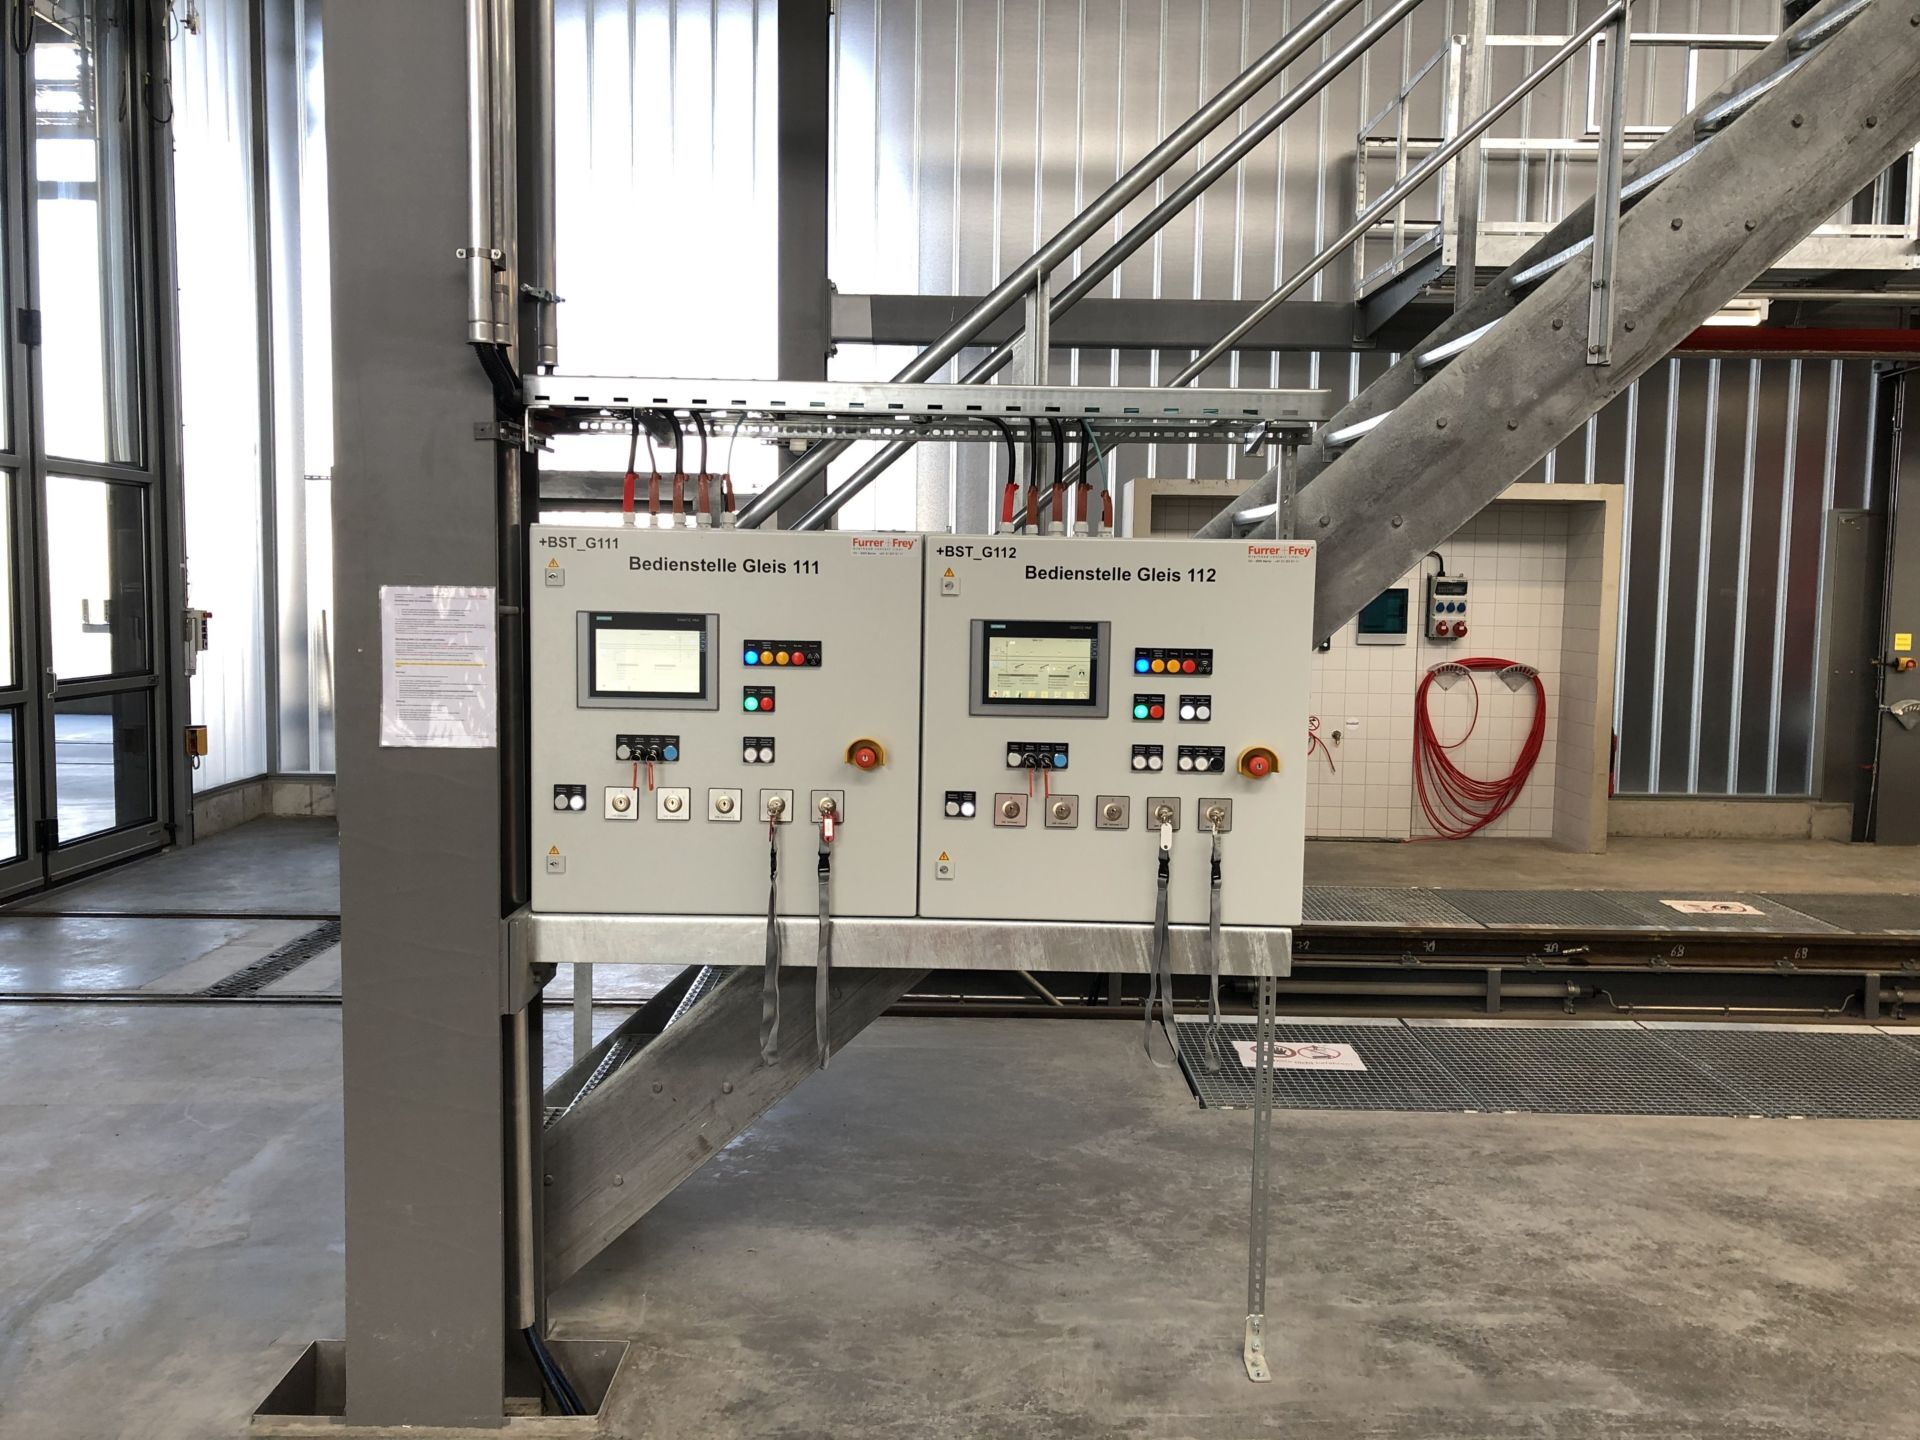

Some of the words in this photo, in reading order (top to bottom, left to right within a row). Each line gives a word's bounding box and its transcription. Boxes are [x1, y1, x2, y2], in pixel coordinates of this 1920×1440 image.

[538, 536, 619, 552] +BST_G111
[852, 537, 884, 547] Furrer
[1248, 545, 1280, 555] Furrer
[936, 545, 1017, 561] +BST_G112
[629, 556, 737, 573] Bedienstelle
[742, 558, 787, 574] Gleis
[793, 559, 819, 574] 111
[1025, 565, 1132, 582] Bedienstelle
[1137, 567, 1182, 582] Gleis
[1187, 568, 1217, 583] 112
